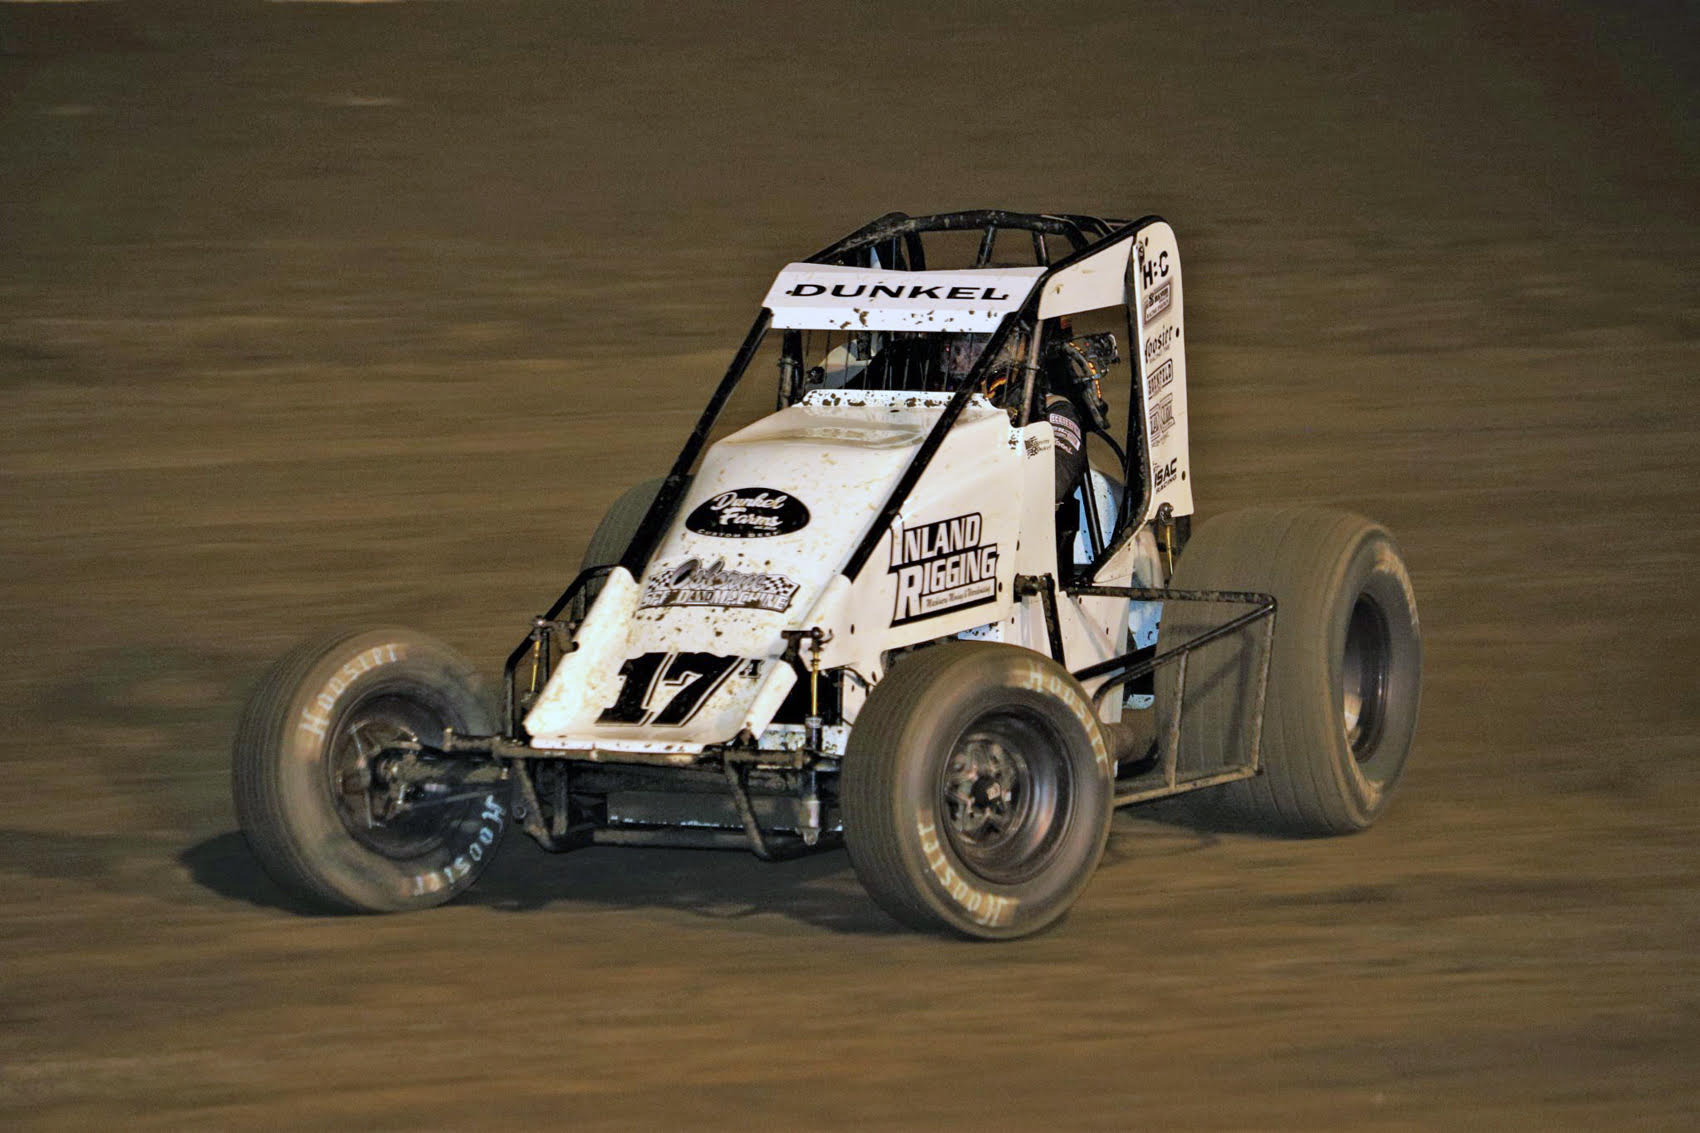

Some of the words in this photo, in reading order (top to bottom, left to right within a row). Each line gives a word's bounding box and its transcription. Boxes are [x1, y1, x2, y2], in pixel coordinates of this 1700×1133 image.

[790, 284, 1009, 301] DUNKEL
[710, 492, 788, 511] Dunkel
[718, 507, 784, 526] Farms
[889, 512, 982, 569] INLAND
[892, 545, 999, 623] RIGGING
